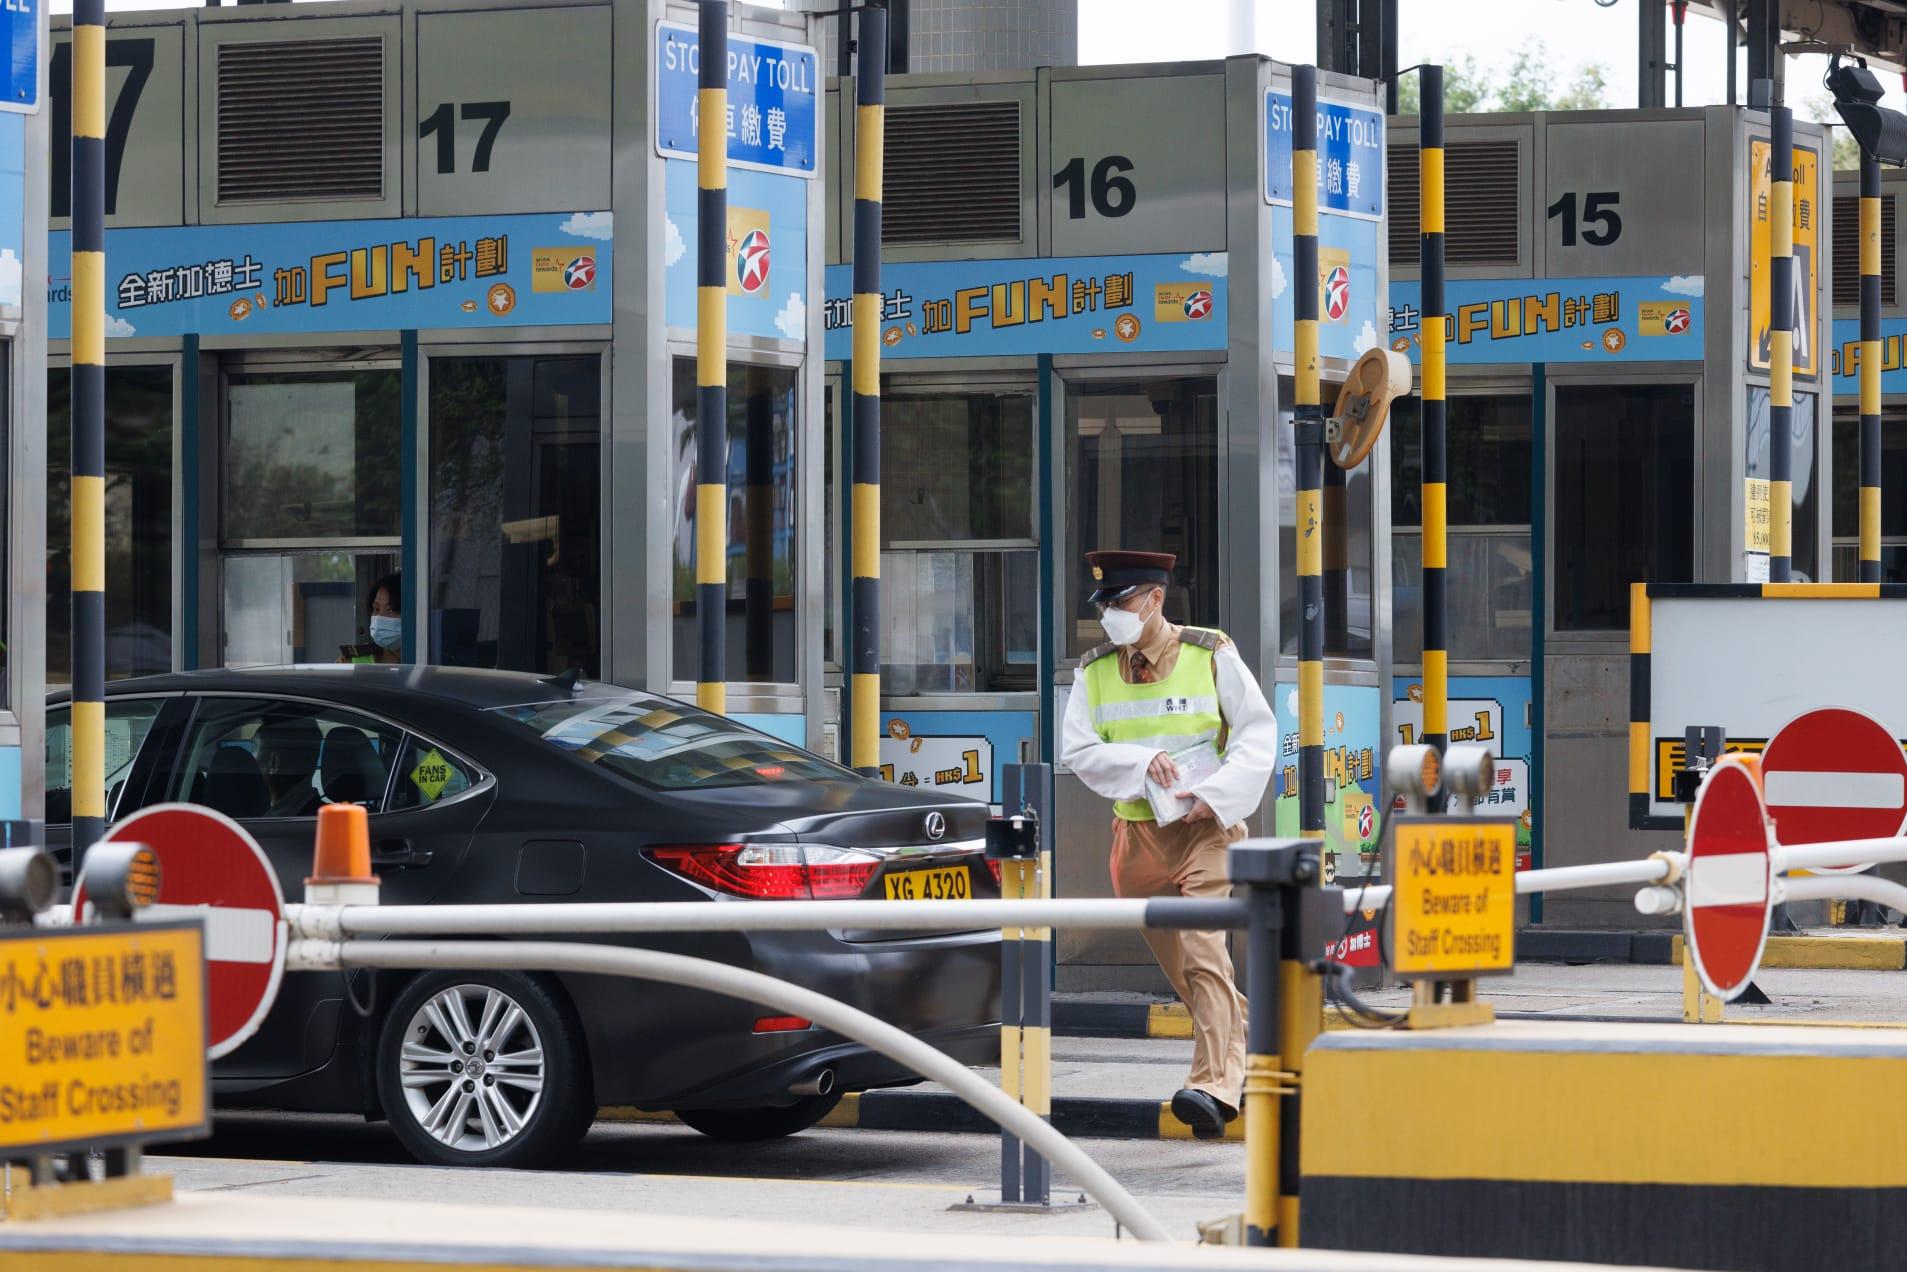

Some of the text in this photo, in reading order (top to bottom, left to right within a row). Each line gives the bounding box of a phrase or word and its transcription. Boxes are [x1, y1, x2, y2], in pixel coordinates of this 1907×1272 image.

[665, 40, 810, 93] STO PAY TOLL
[419, 101, 511, 174] 17
[689, 95, 787, 151] 繳費
[1271, 102, 1378, 148] ST PAY TOLL
[1053, 155, 1136, 219] 16
[1289, 157, 1360, 199] 繳費
[1548, 191, 1622, 246] 15
[118, 255, 263, 309] 全新加德士
[419, 765, 446, 776] FANS
[419, 774, 446, 784] IN CAR
[890, 871, 966, 900] XG 4320
[1423, 886, 1489, 916] Beware of
[1408, 927, 1502, 960] Staff Crossing
[26, 1016, 155, 1066] Beware of
[0, 1072, 181, 1125] Staff Crossing
